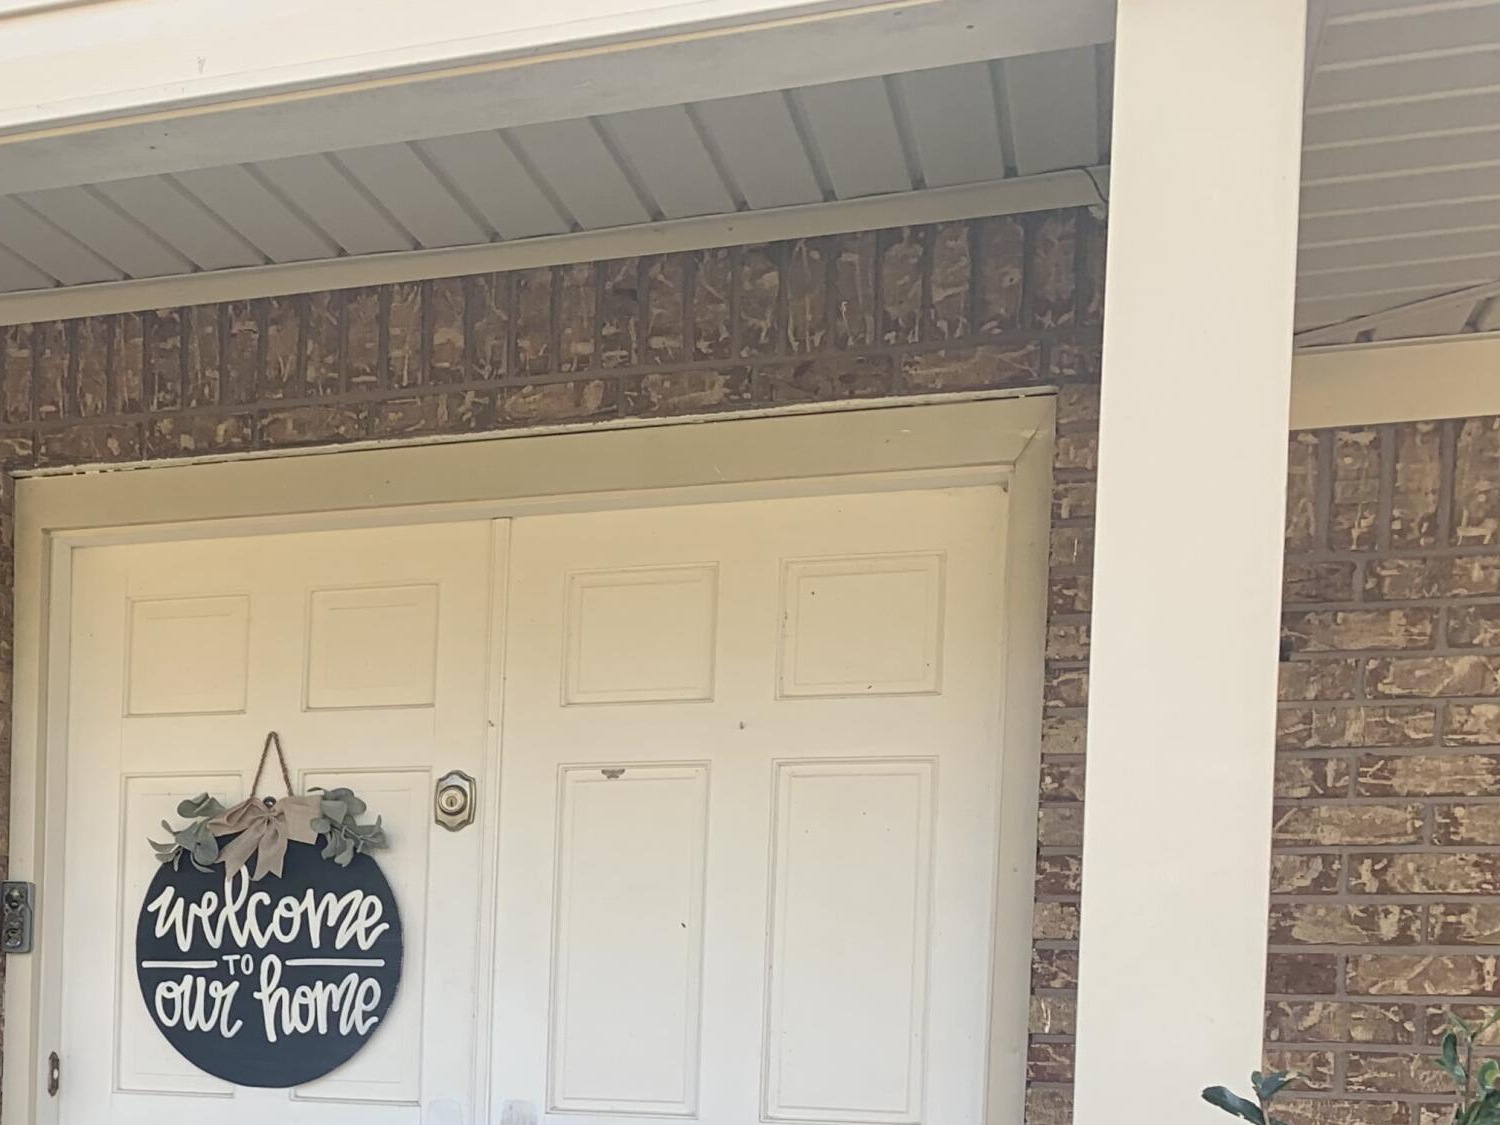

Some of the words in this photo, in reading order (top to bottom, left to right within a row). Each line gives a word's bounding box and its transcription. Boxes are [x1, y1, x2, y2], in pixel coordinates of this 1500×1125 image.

[147, 864, 389, 952] welcome
[154, 974, 243, 1038] our
[253, 953, 382, 1043] home
[222, 953, 254, 976] TO
